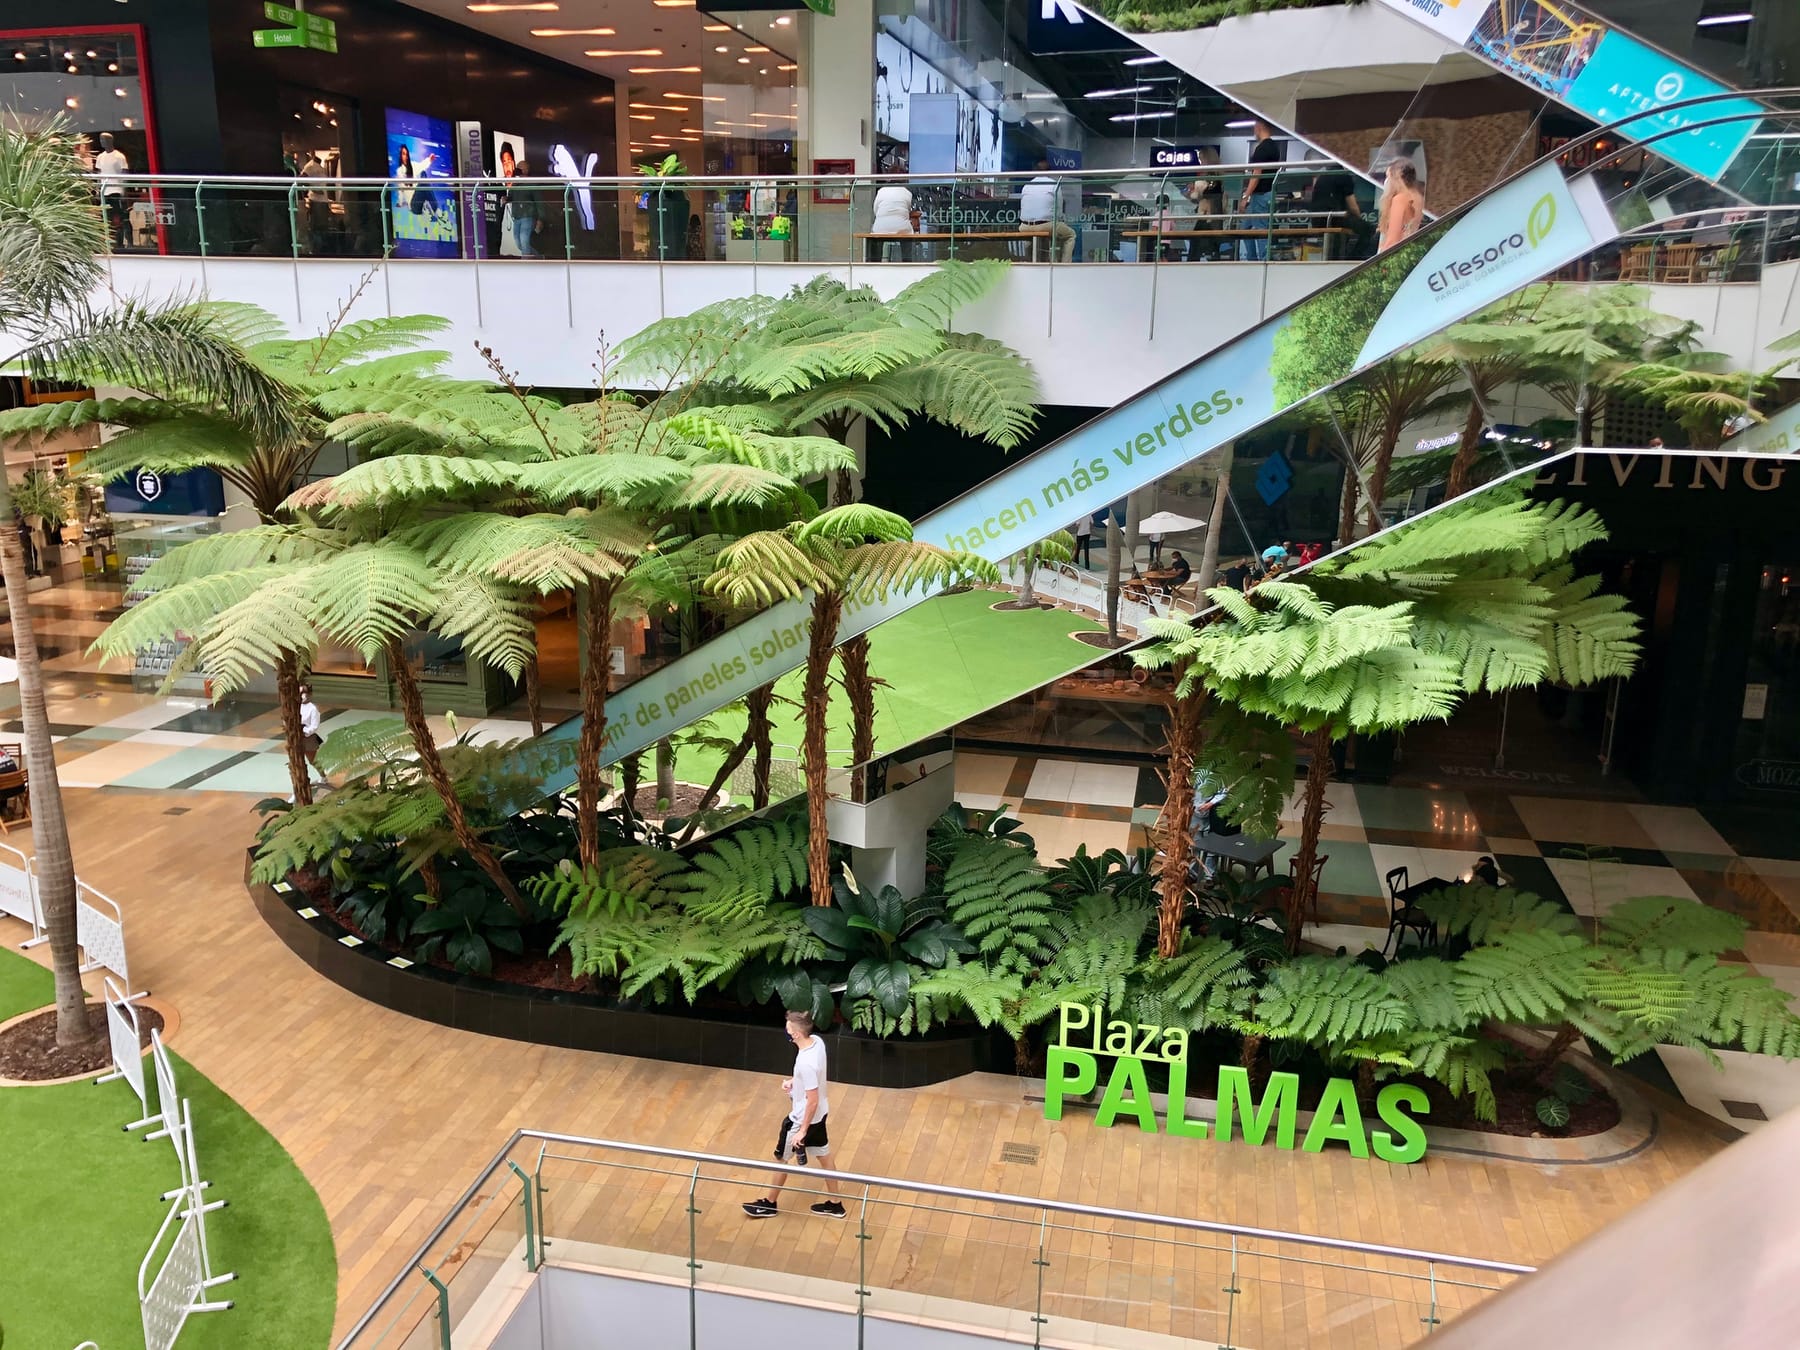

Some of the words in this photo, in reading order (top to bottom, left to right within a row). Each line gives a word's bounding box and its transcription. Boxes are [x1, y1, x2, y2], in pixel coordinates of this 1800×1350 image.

[273, 33, 293, 44] Hotel
[1053, 157, 1076, 168] vivo
[1156, 150, 1192, 165] Cajas
[929, 206, 1022, 224] ktronix.co
[1114, 204, 1128, 214] LG
[1427, 270, 1448, 292] El
[1446, 233, 1524, 280] Tesoro
[635, 702, 662, 727] de
[664, 655, 747, 718] paneles
[749, 616, 815, 666] solar
[944, 497, 1038, 552] hacen
[1041, 458, 1110, 508] más
[1113, 389, 1244, 466] verdes.
[1756, 766, 1800, 786] MOZ
[1059, 1001, 1189, 1064] Plaza
[1044, 1045, 1431, 1164] PALMAS
